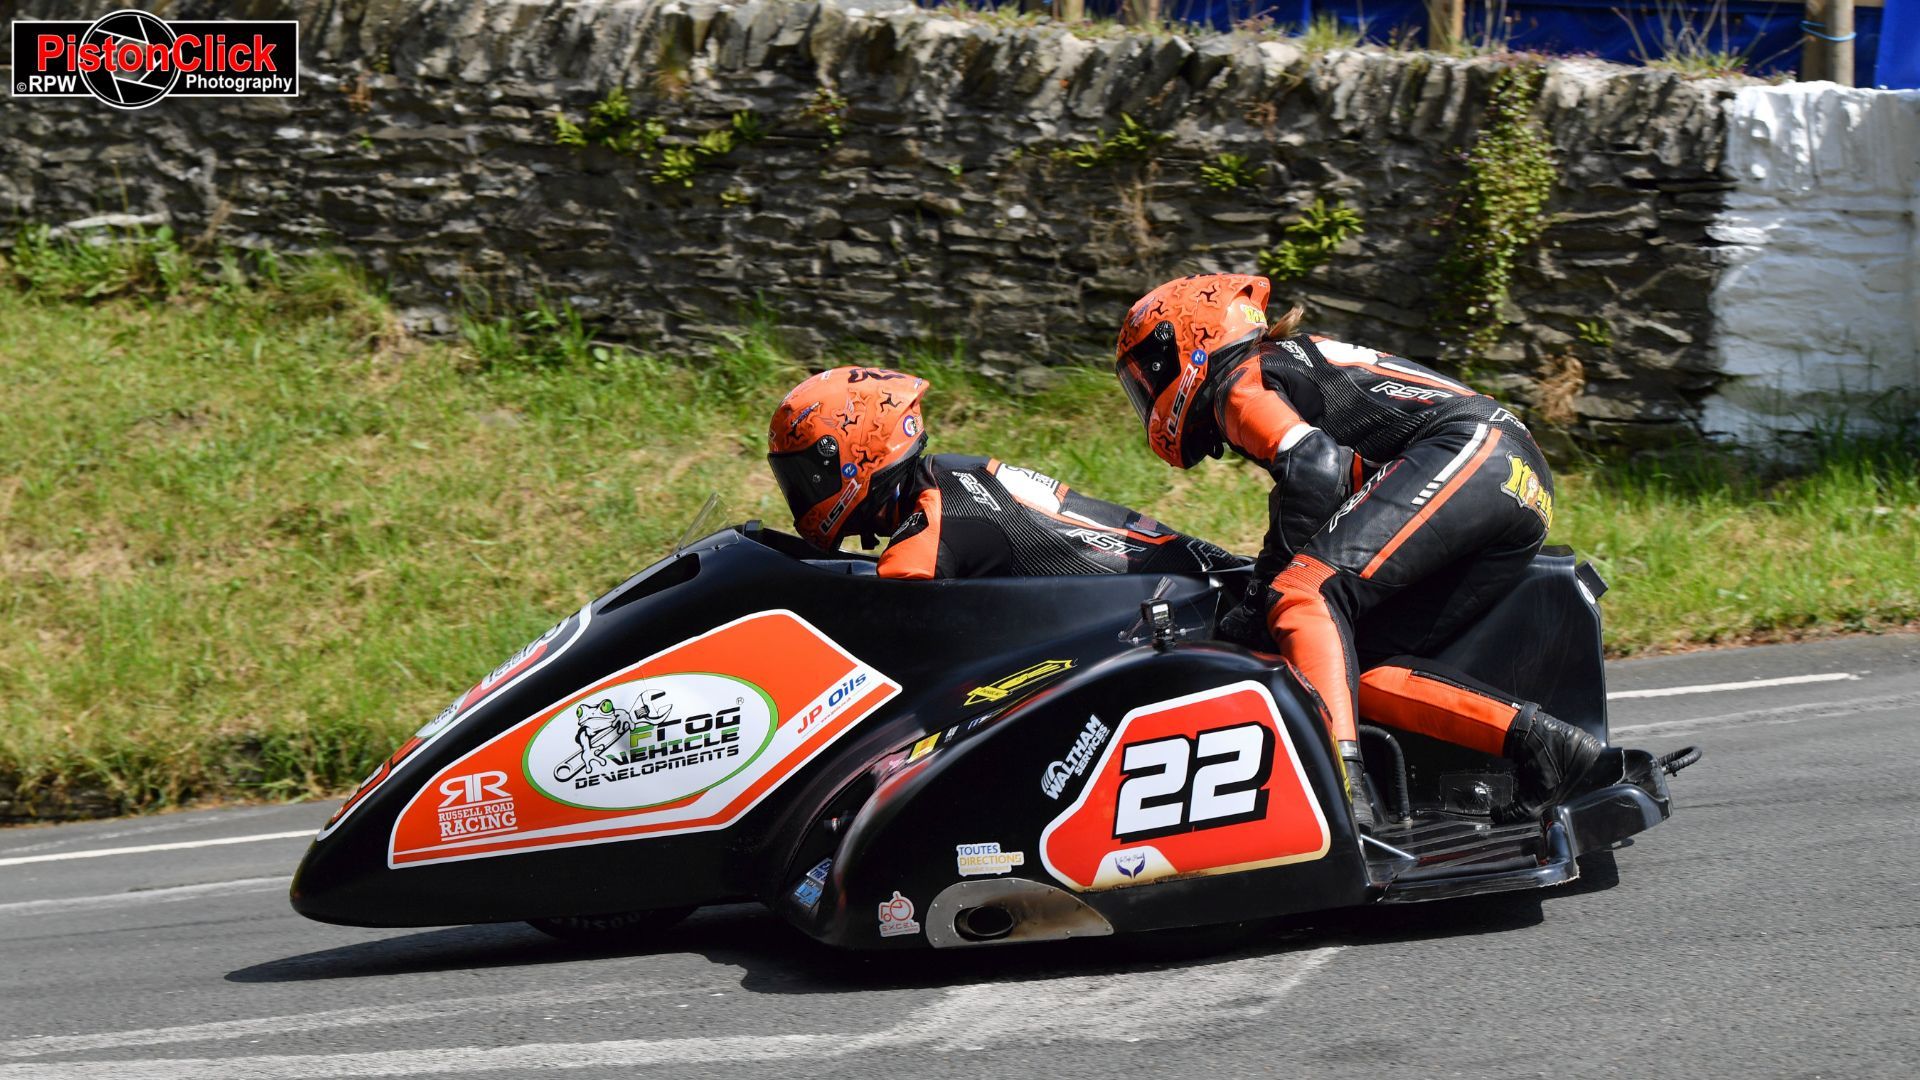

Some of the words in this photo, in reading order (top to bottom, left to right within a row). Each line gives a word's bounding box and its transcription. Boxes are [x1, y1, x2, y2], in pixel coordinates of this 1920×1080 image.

[1369, 380, 1454, 400] RST
[818, 477, 863, 536] LS2
[1065, 528, 1148, 555] RST
[797, 704, 823, 735] JP
[828, 673, 867, 707] Oils
[605, 727, 740, 766] VEHICLE
[1046, 713, 1102, 800] WALTHAM
[1074, 723, 1108, 777] SERVICES
[575, 744, 740, 790] DEVELOPMENTS
[1113, 722, 1266, 837] 22
[438, 807, 483, 822] RUSSELL
[484, 802, 515, 815] ROAD
[439, 811, 517, 837] RACING
[959, 844, 999, 856] TOUTES
[959, 854, 1022, 867] DIRECTIONS
